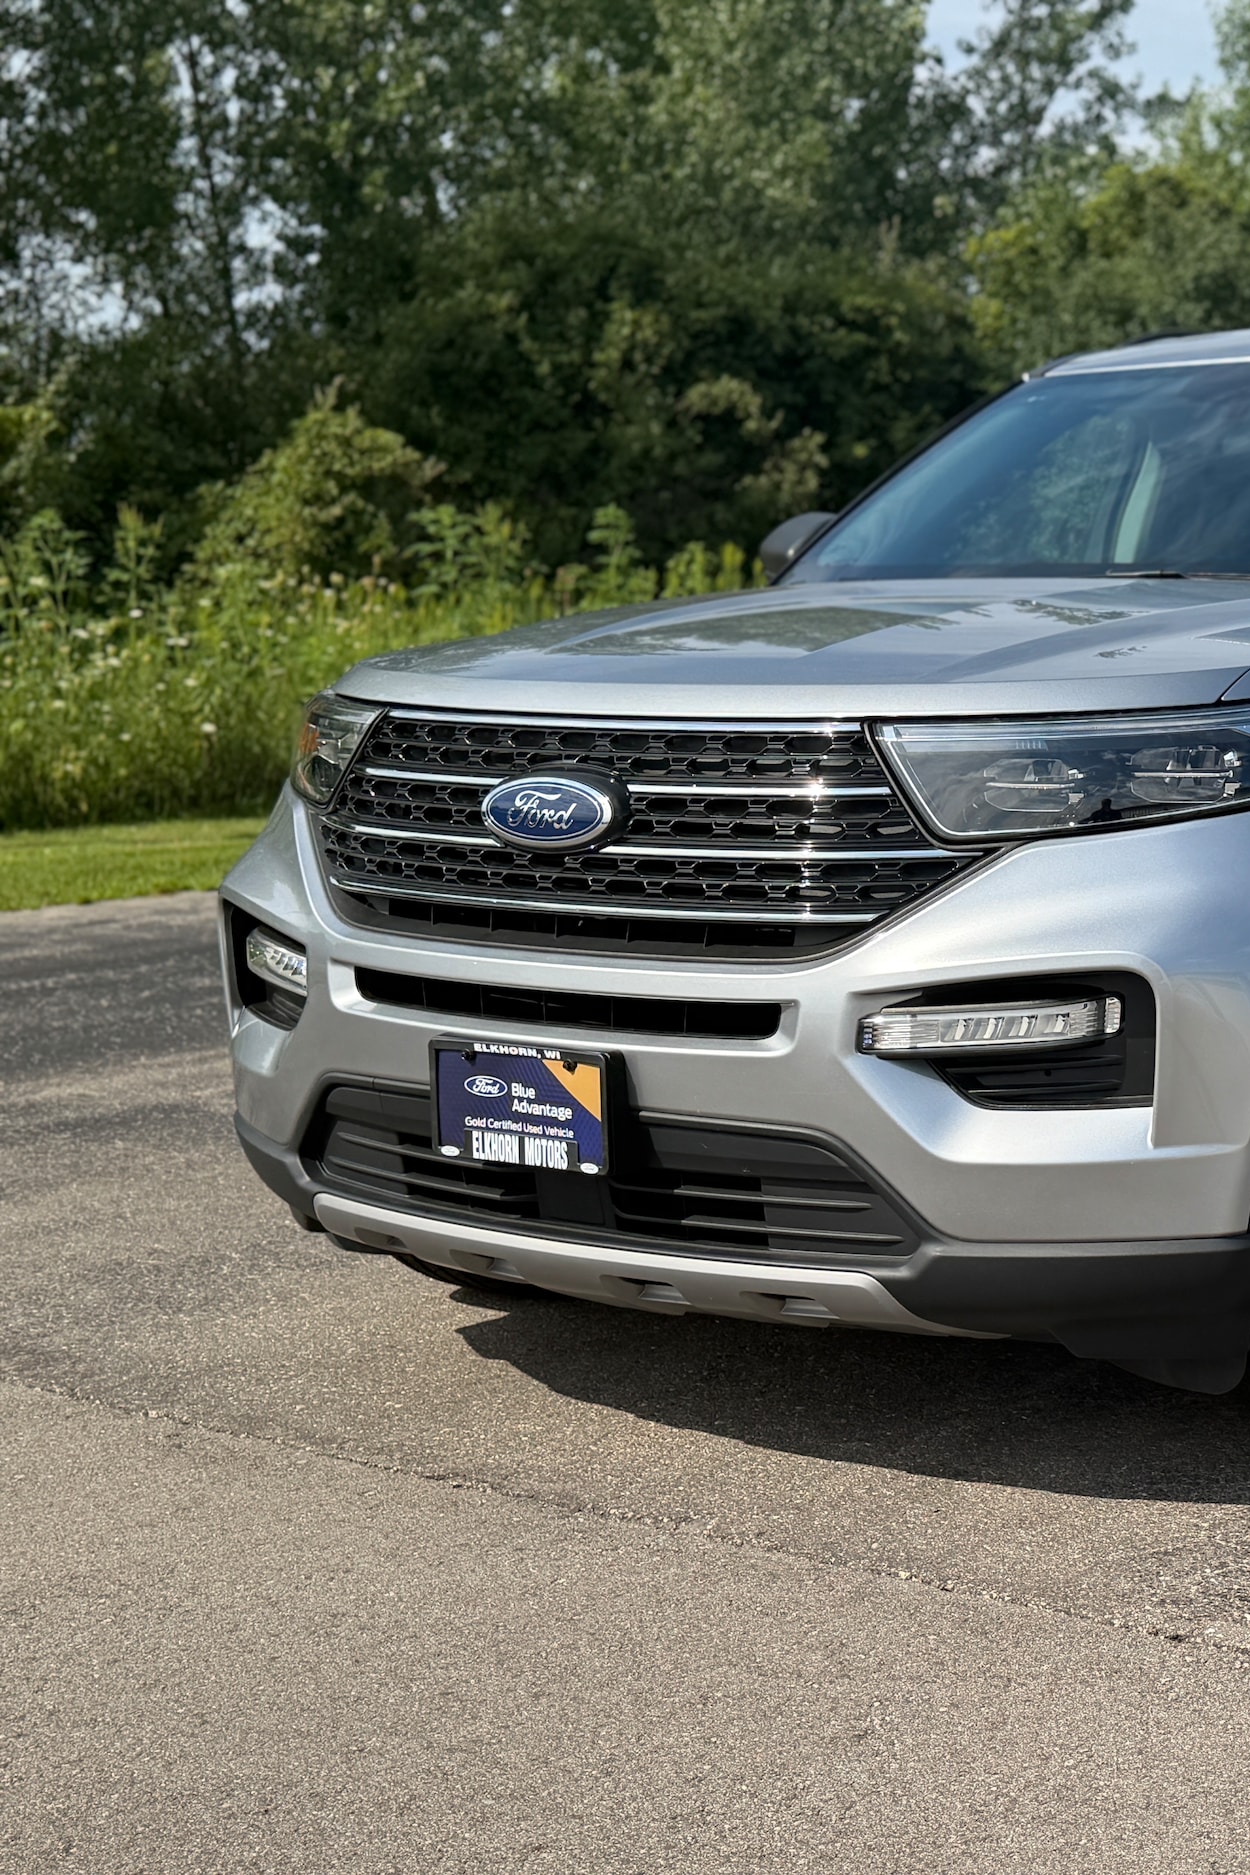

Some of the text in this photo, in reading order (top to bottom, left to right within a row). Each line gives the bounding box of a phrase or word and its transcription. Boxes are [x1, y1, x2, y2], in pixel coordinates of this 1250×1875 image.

[507, 790, 578, 830] Ford
[473, 1043, 562, 1060] ELKHORN, WI
[472, 1078, 500, 1095] Ford
[511, 1082, 536, 1099] Blue
[511, 1099, 573, 1121] Advantage
[464, 1116, 575, 1139] Gold Certified Used Vehicle
[472, 1131, 569, 1170] ELKHORN MOTORS
